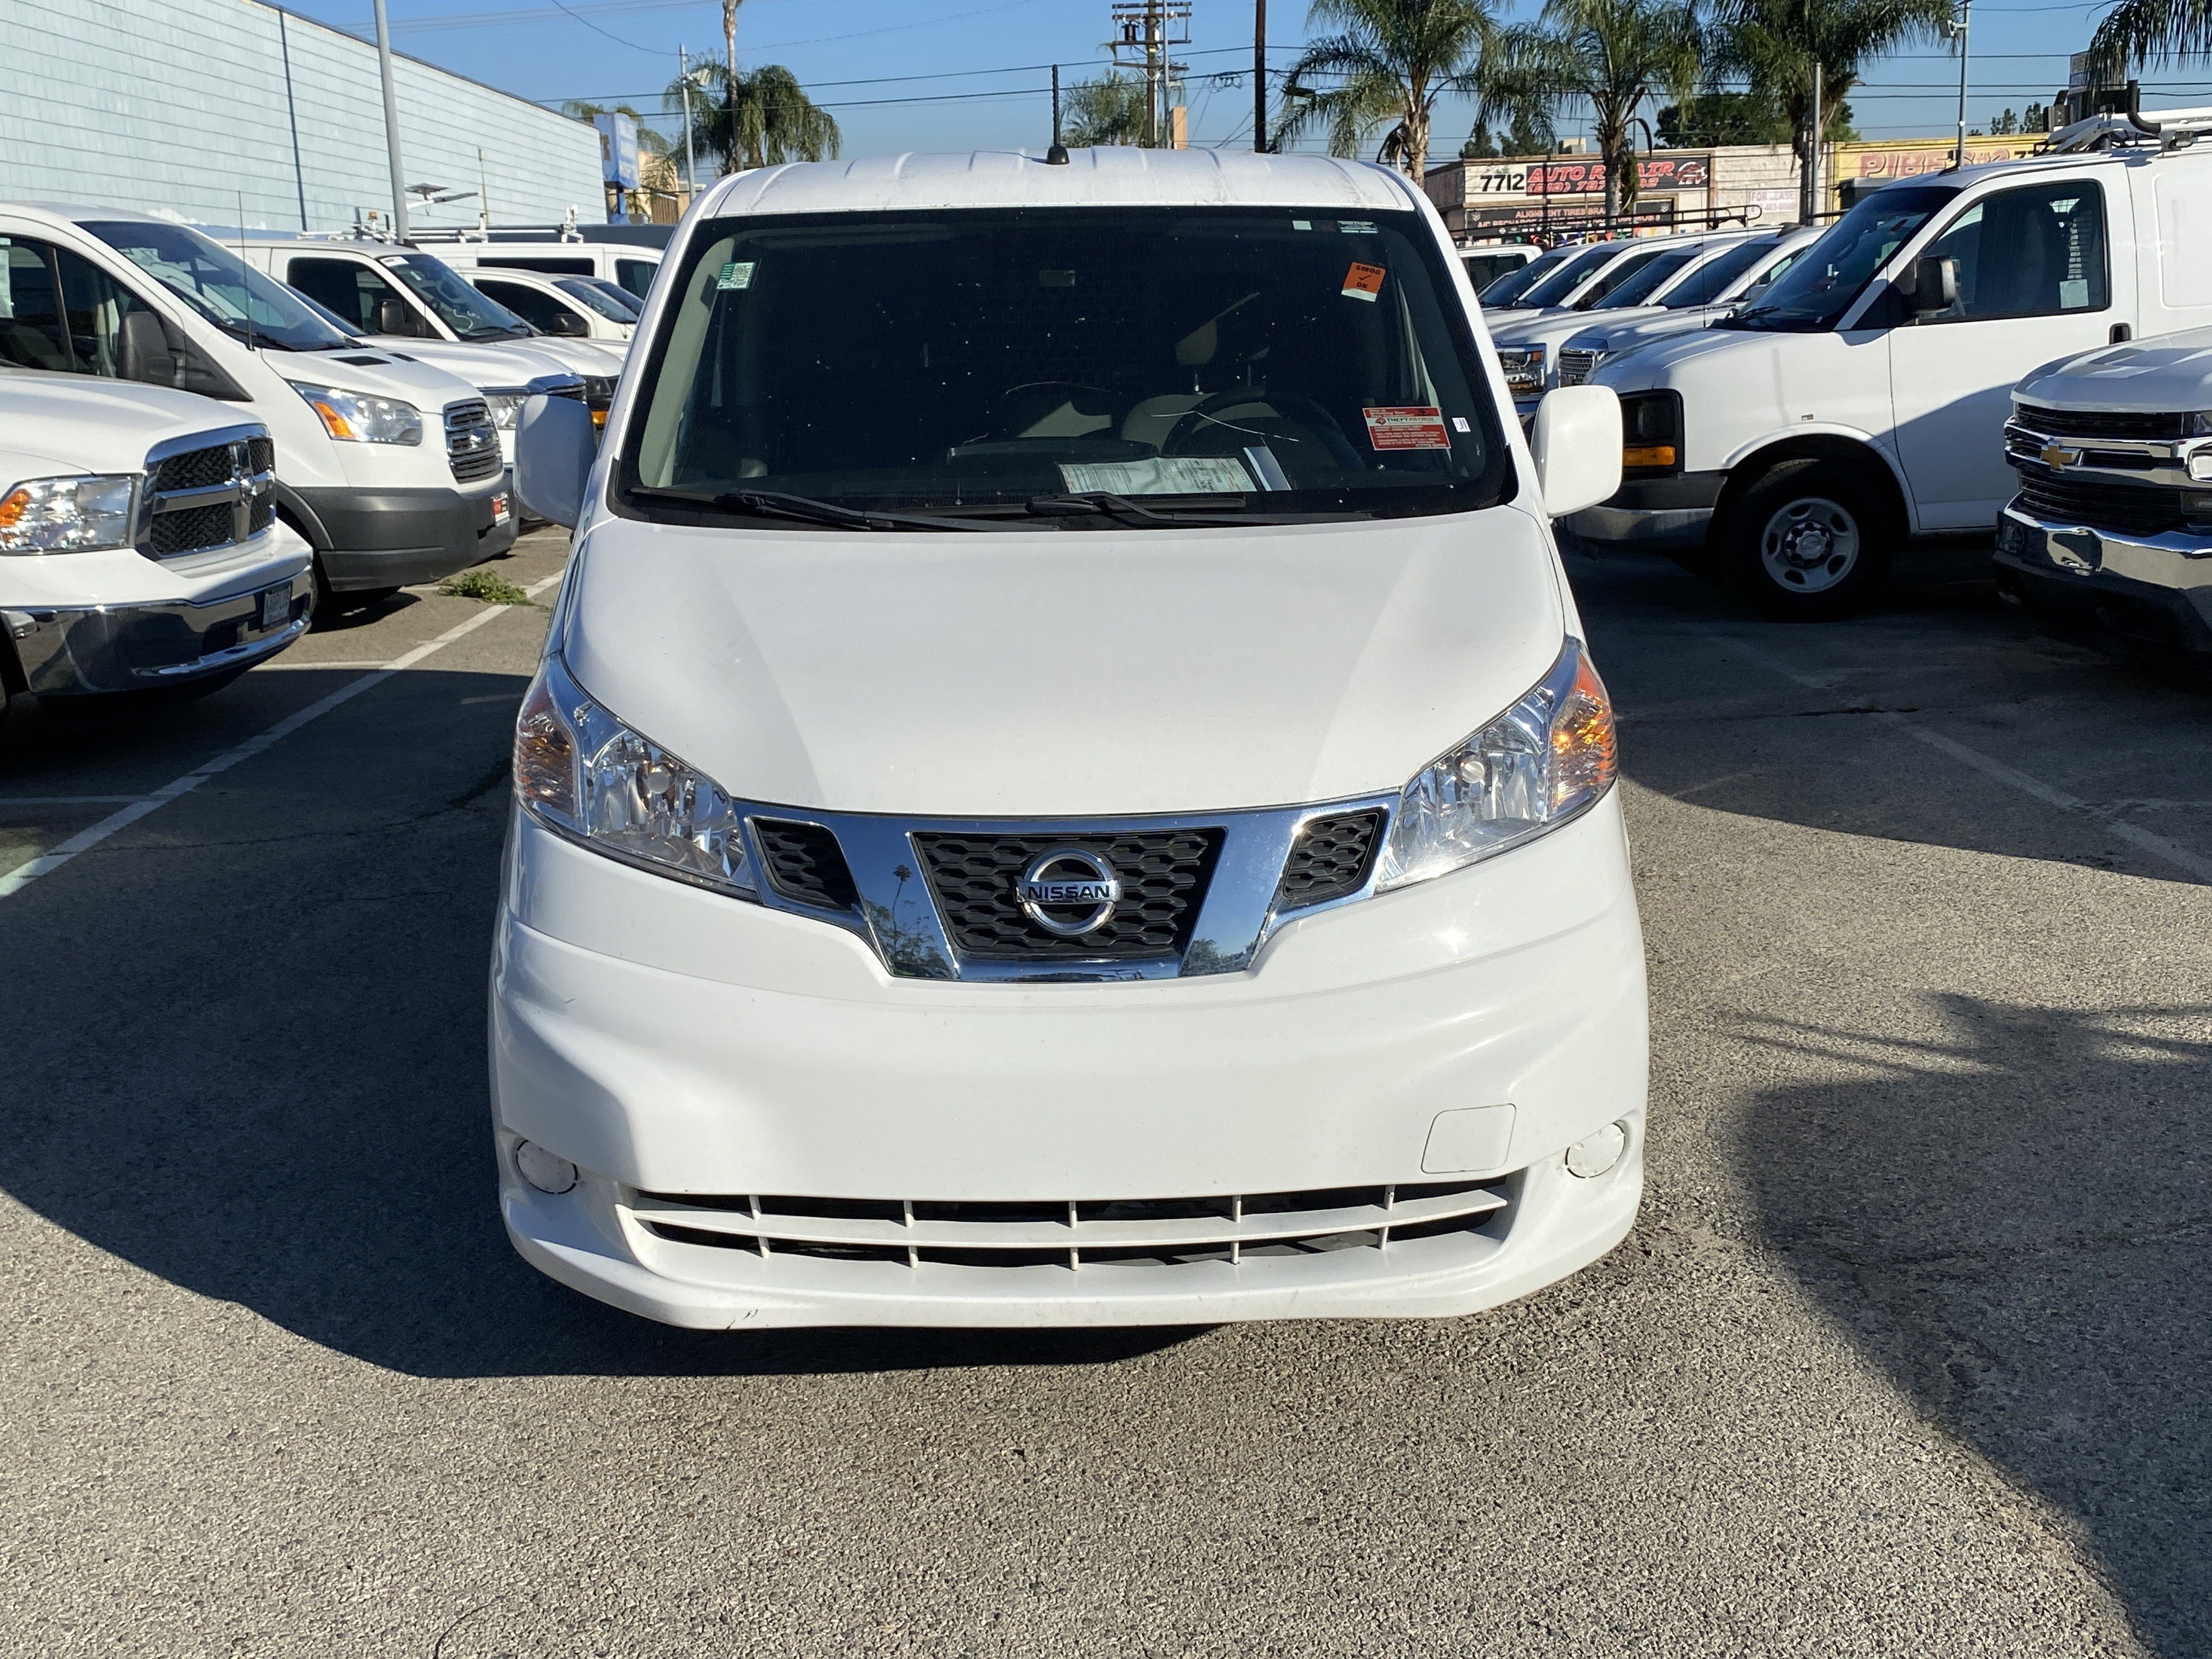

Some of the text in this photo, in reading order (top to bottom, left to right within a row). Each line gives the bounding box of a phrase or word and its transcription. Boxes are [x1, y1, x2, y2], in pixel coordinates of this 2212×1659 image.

[1527, 161, 1675, 183] AUTO RAIR
[1480, 173, 1525, 191] 7712
[1751, 191, 1767, 201] FOR
[1515, 210, 1561, 218] ALIGNENT
[1355, 265, 1381, 274] SMOG
[1028, 885, 1110, 899] NISSAN
